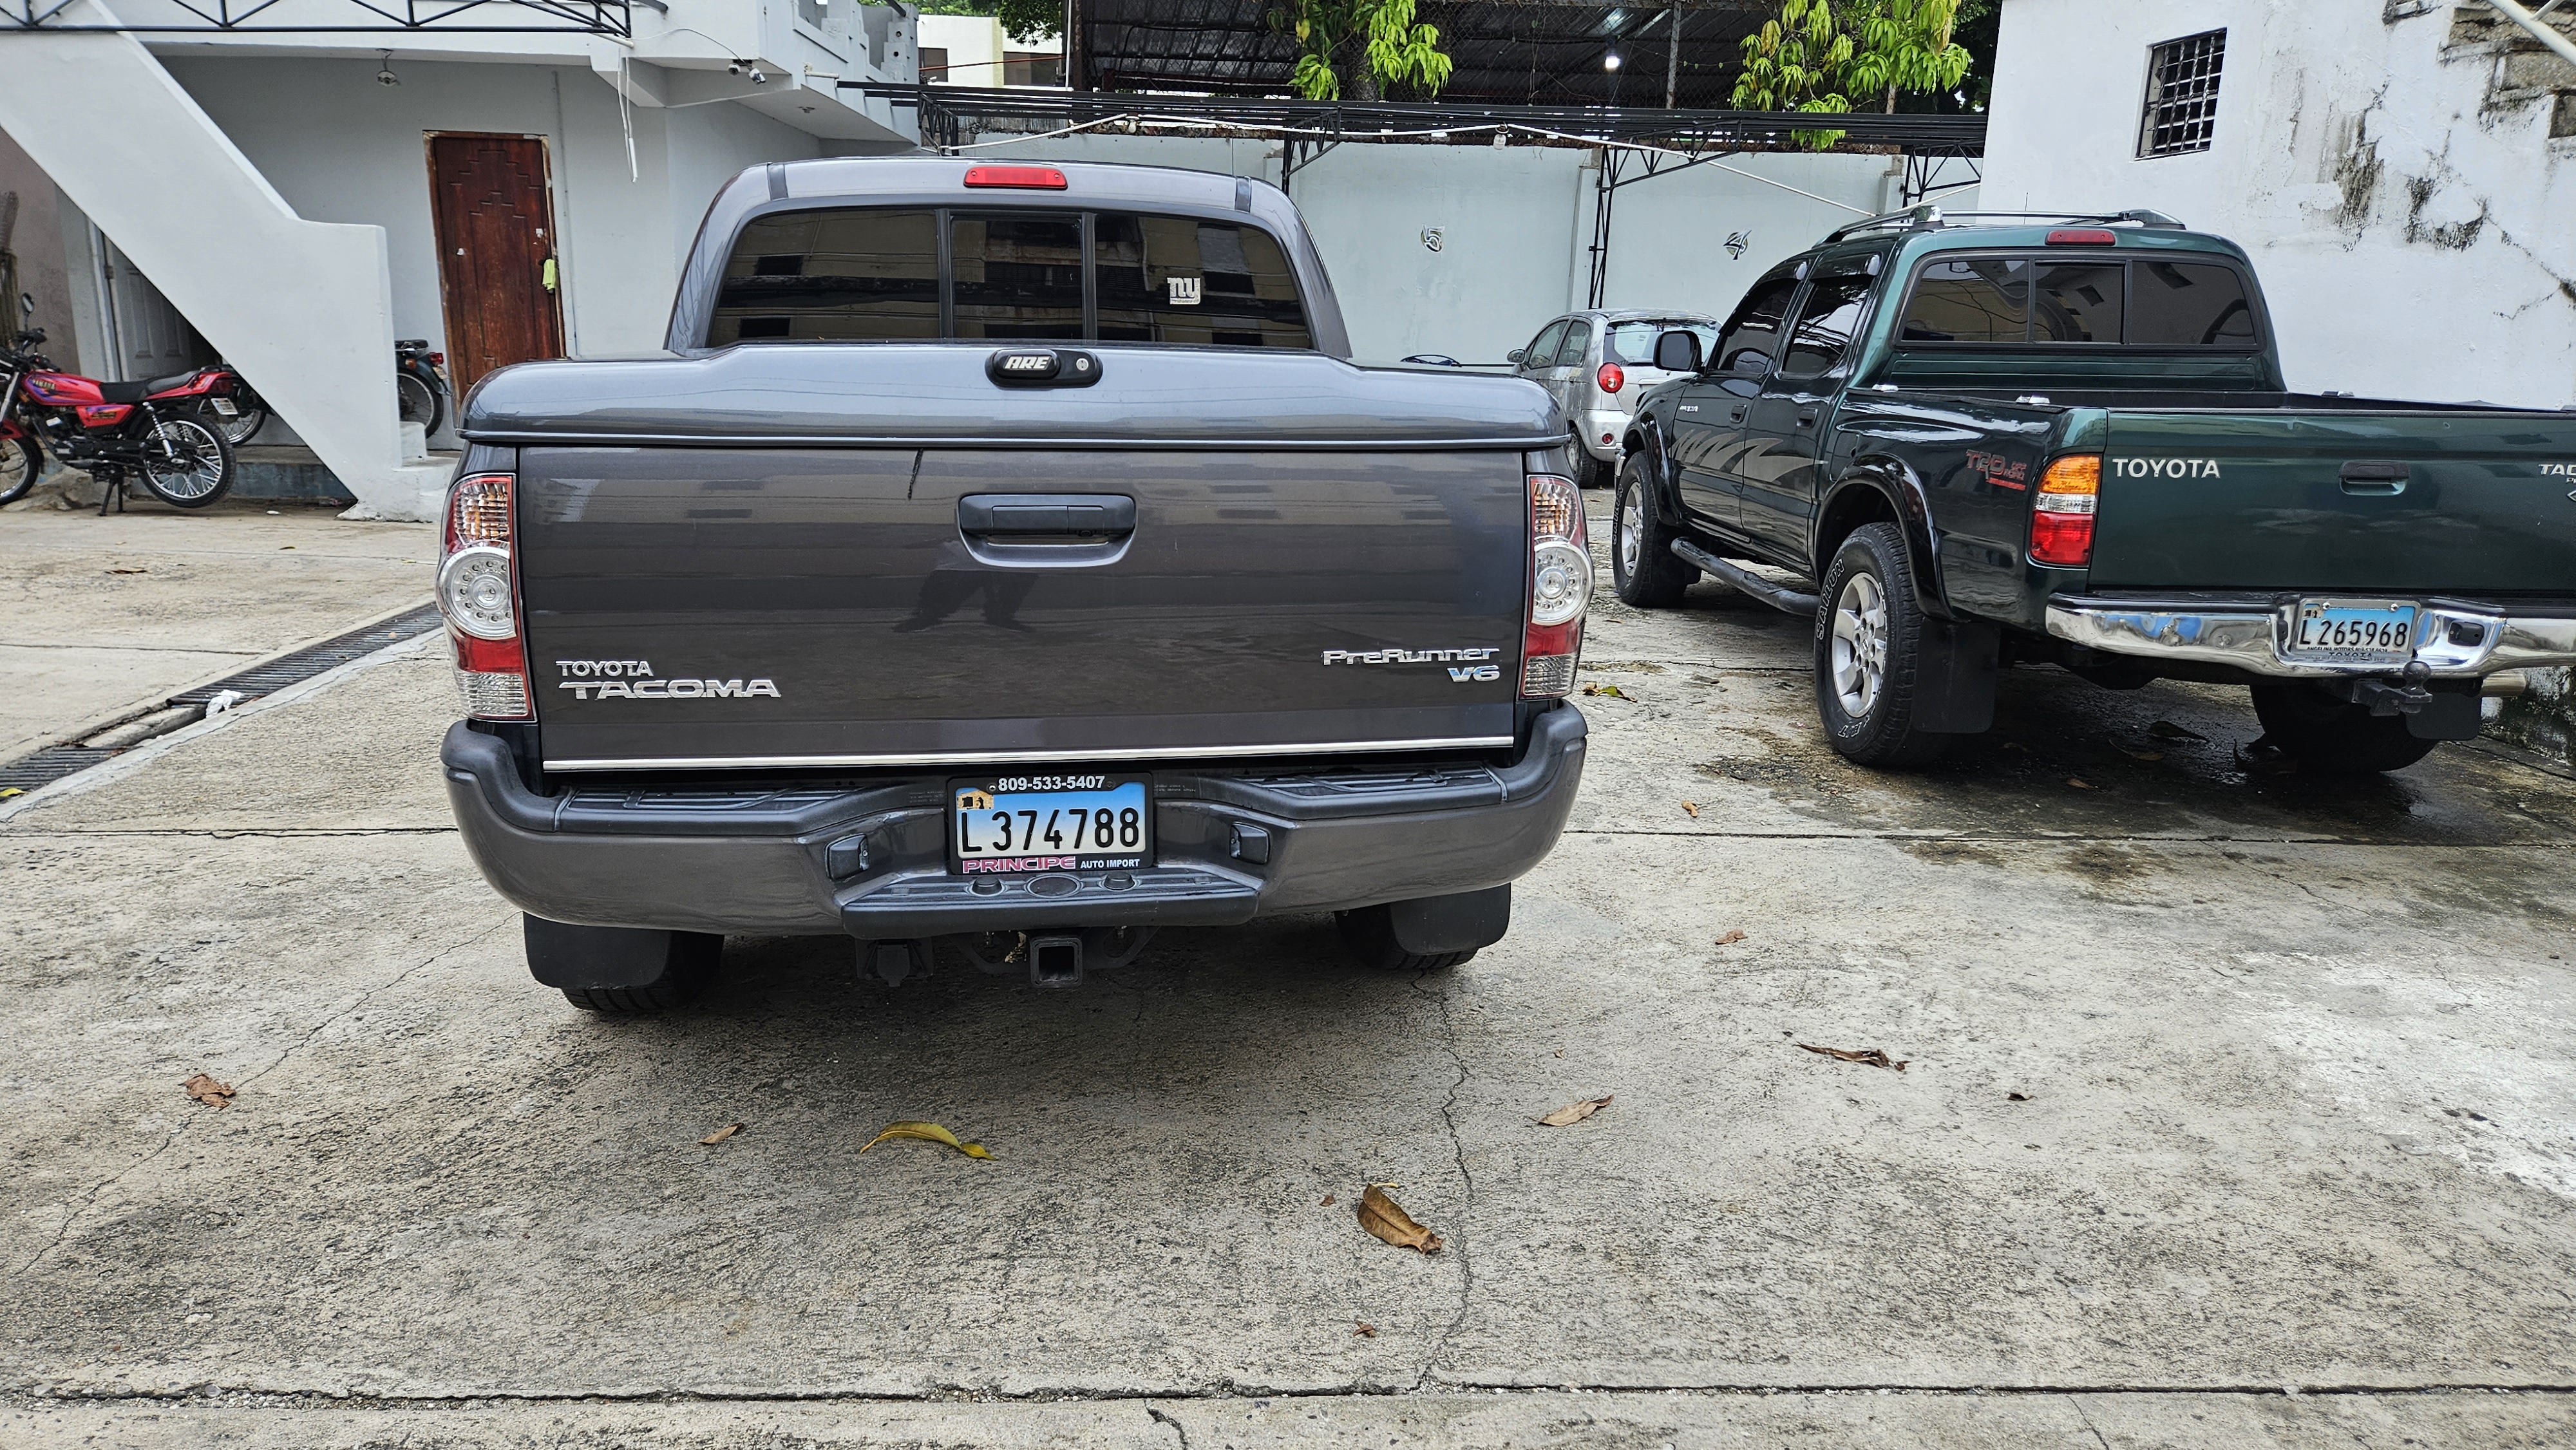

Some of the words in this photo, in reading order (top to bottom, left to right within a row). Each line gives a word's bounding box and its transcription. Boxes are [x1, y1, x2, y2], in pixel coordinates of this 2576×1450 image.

[1422, 225, 1444, 252] 5
[1723, 229, 1752, 261] 4
[1004, 355, 1052, 370] ARE
[1966, 449, 2007, 479] TRD
[2112, 458, 2221, 478] TOYOTA
[1816, 558, 1844, 640] SAILUN
[2300, 619, 2408, 647] L265968
[1322, 648, 1500, 666] PreRunner
[555, 661, 654, 677] TOYOTA
[1447, 665, 1500, 682] V6
[558, 679, 782, 700] TACOMA
[998, 776, 1105, 791] 809-533-5407
[961, 807, 1140, 852] L374788
[962, 856, 1076, 874] PRINCIPE
[1080, 860, 1104, 869] AUTO
[1106, 858, 1140, 869] IMPORT
